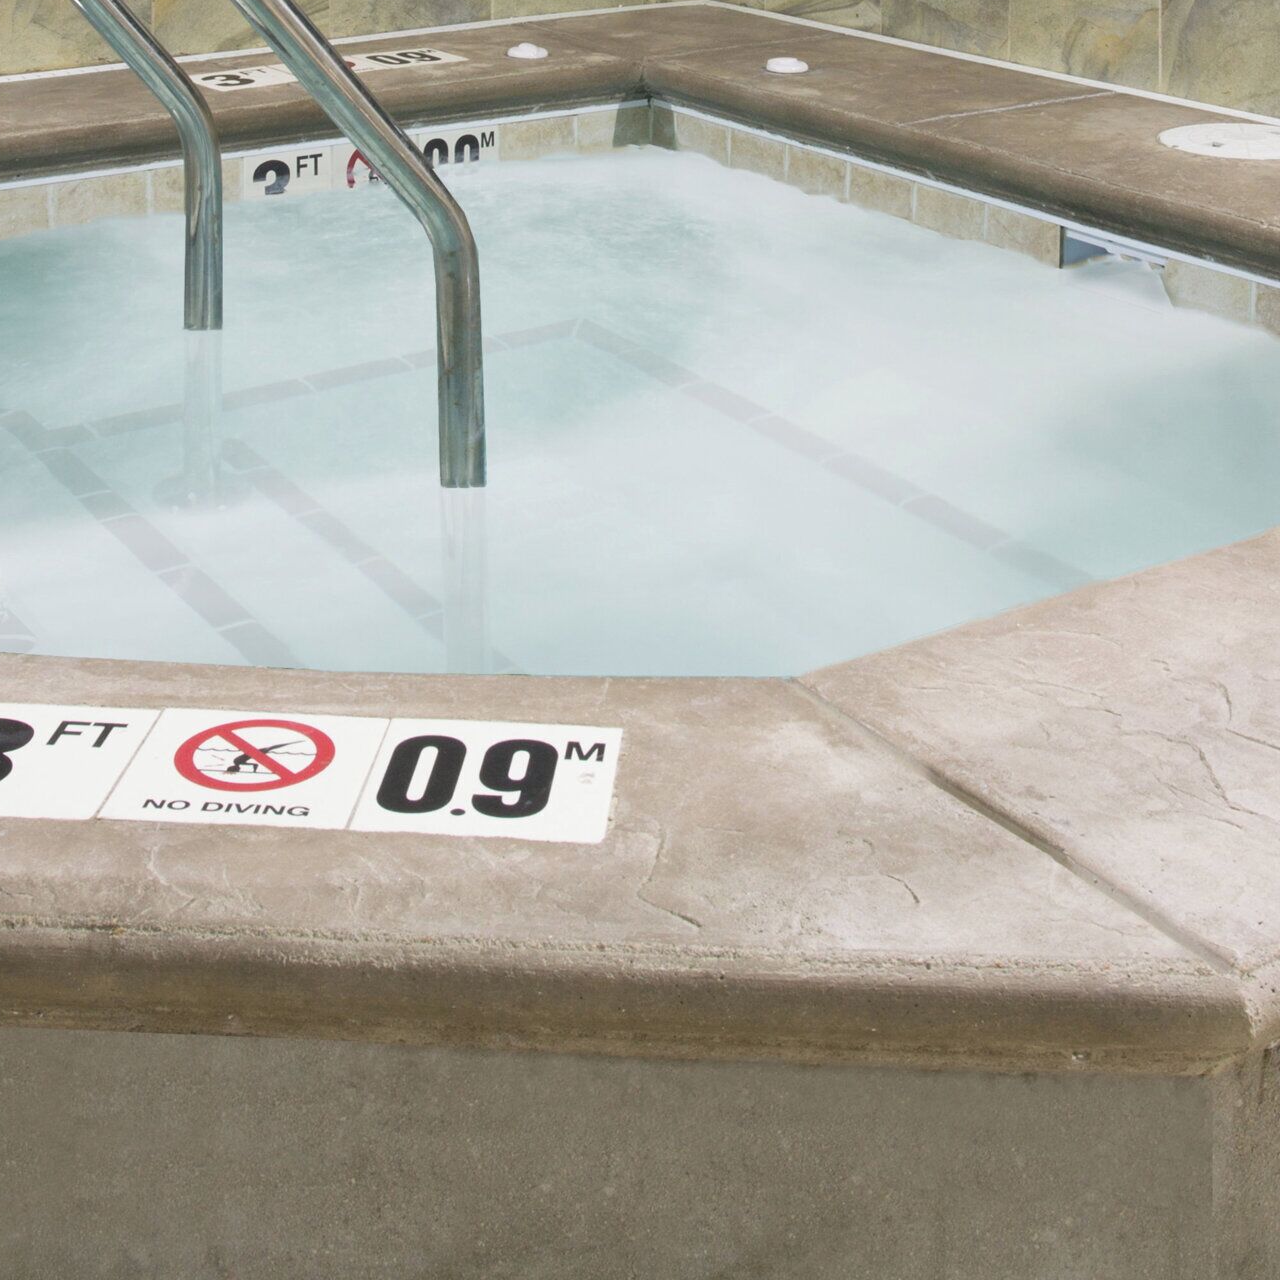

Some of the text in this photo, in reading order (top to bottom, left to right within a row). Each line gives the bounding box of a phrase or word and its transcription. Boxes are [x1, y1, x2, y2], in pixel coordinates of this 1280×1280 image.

[201, 74, 255, 86] 3
[481, 131, 494, 148] M
[297, 153, 323, 178] FT
[46, 720, 128, 748] FT
[376, 734, 606, 819] 0.9 M
[142, 799, 311, 817] NO DIVING
